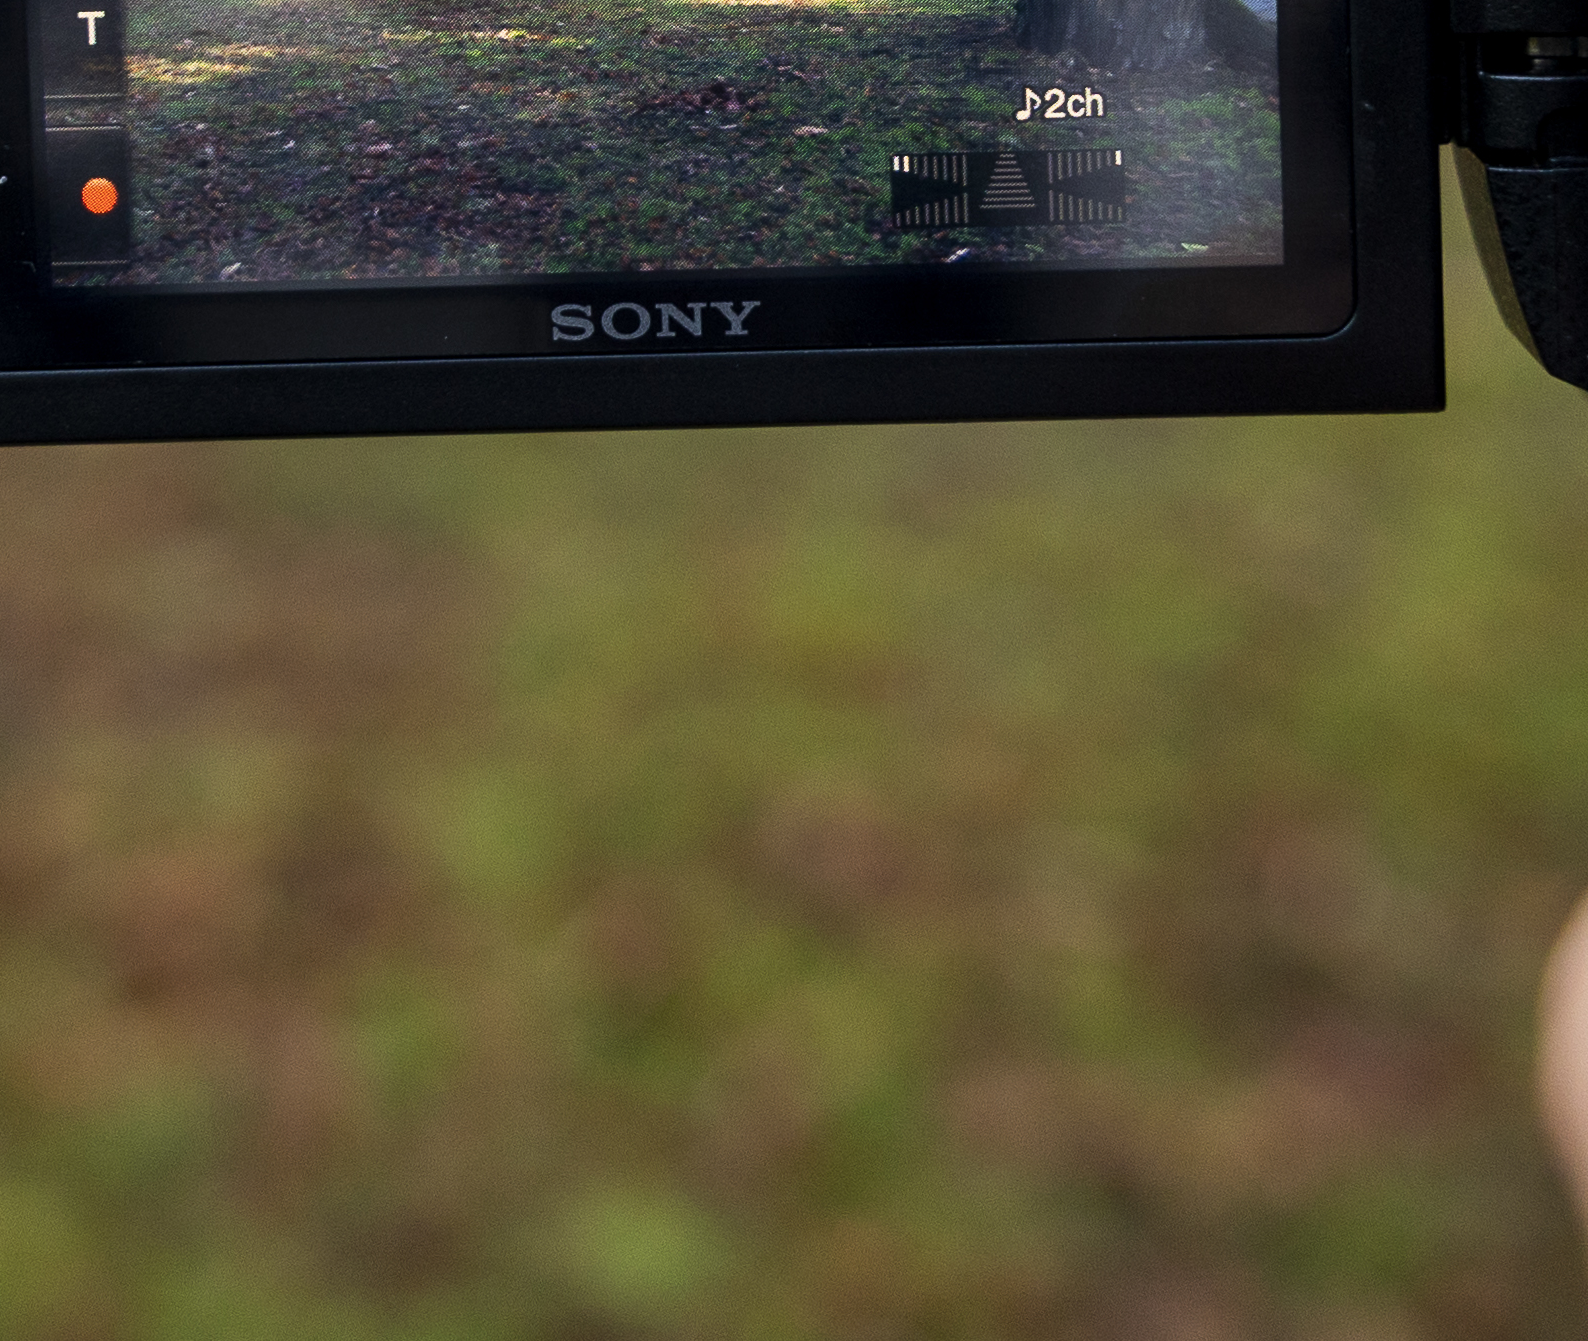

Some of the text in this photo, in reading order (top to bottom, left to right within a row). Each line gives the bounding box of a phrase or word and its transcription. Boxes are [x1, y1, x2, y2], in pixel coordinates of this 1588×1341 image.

[78, 10, 106, 46] T
[1045, 88, 1104, 119] 2ch
[551, 301, 761, 342] SONY
